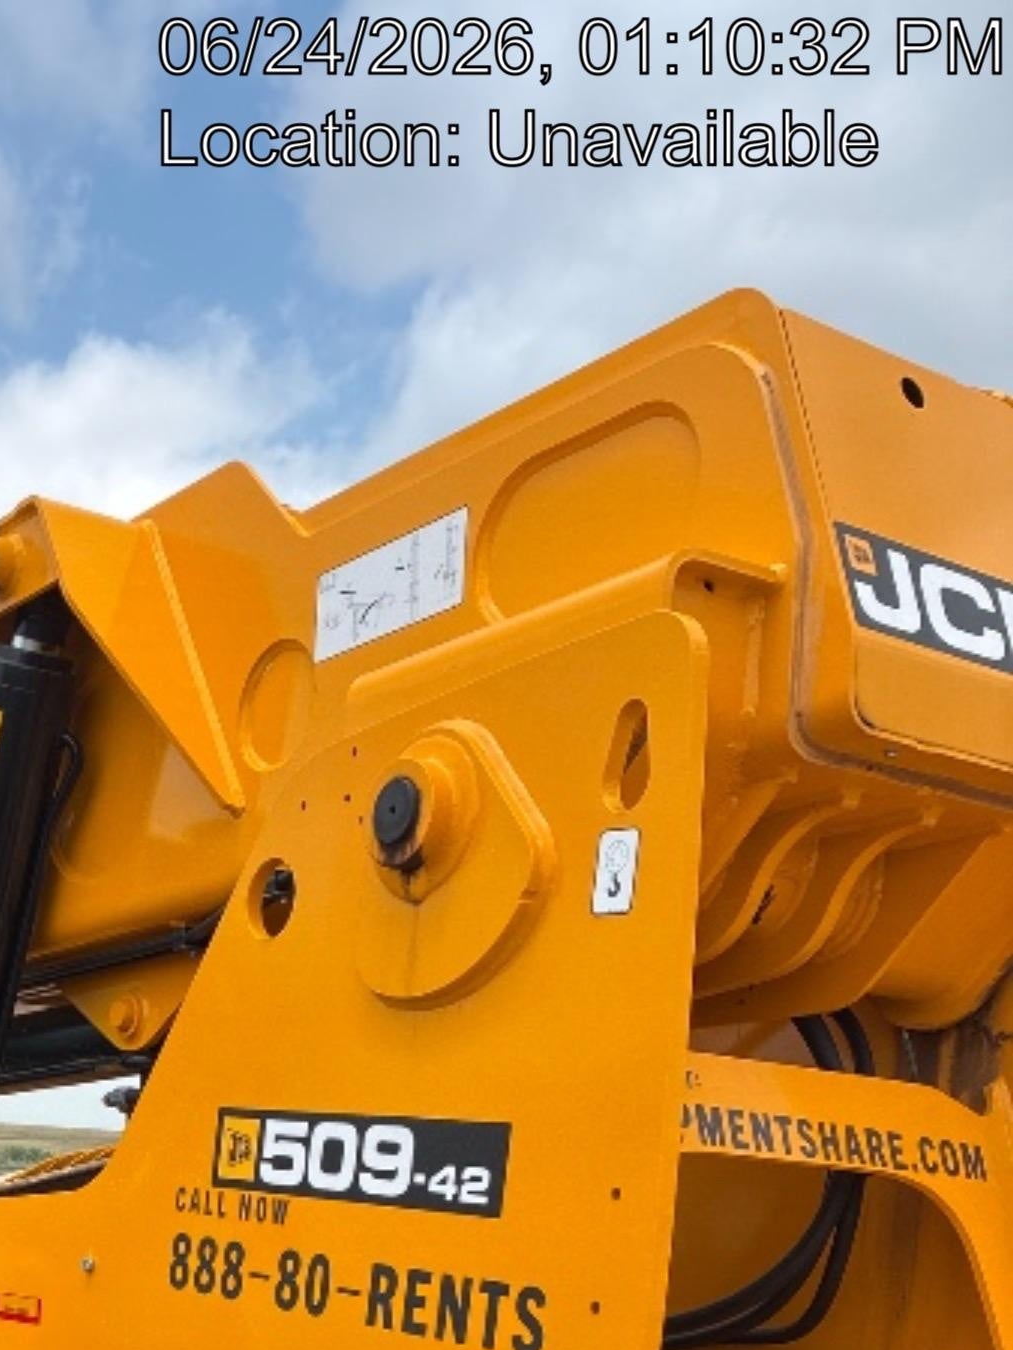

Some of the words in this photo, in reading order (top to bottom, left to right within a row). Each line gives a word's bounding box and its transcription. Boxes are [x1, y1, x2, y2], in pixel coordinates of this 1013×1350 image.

[259, 1118, 491, 1205] 509-42
[174, 1187, 227, 1220] CALL
[238, 1193, 291, 1226] NOW
